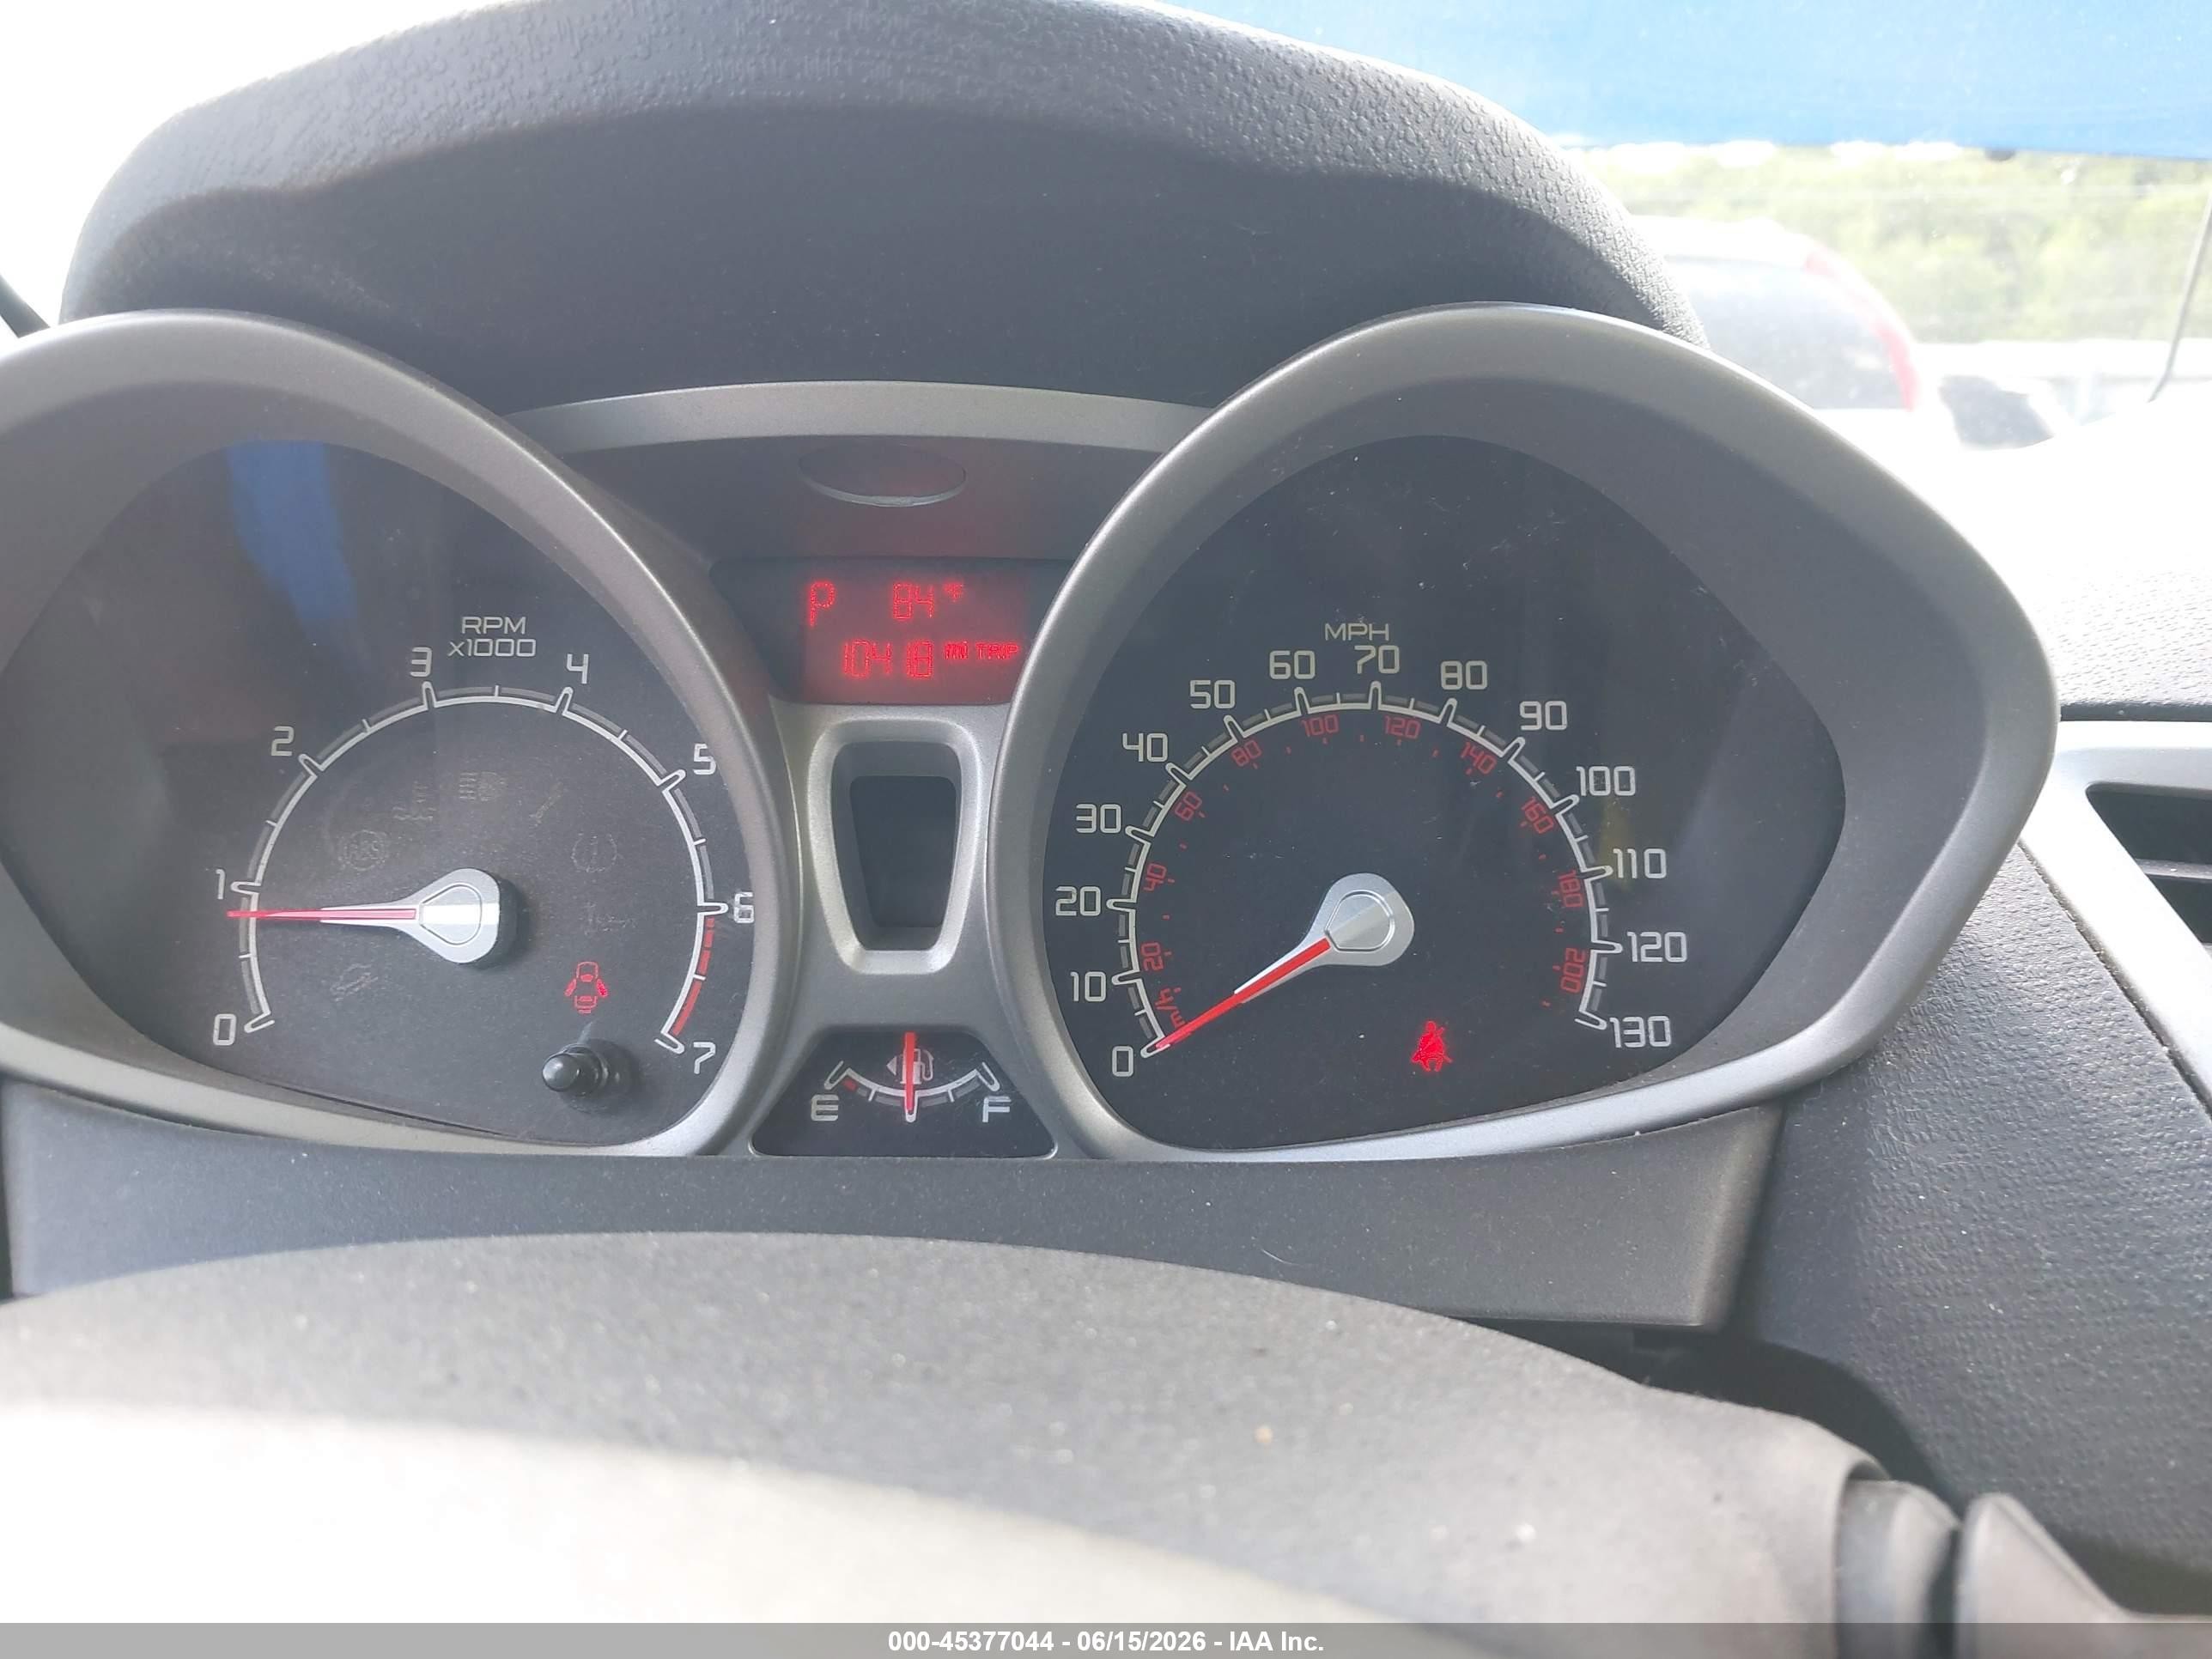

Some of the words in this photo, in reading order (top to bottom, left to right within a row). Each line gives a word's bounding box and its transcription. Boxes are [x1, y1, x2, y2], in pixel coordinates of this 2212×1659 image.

[809, 581, 836, 626] P
[892, 581, 934, 621] 84
[461, 617, 526, 635] RPM
[1325, 623, 1389, 641] MPH
[410, 647, 432, 677] 3
[975, 642, 1019, 659] TRIP
[1269, 650, 1316, 680] 60
[1354, 645, 1401, 674] 70
[567, 653, 589, 684] 4
[1441, 660, 1488, 690] 80
[1190, 679, 1236, 709] 50
[1301, 714, 1340, 738] 100
[1383, 715, 1421, 740] 120
[1520, 701, 1568, 731] 90
[271, 726, 295, 757] 2
[1122, 732, 1168, 763] 40
[1231, 740, 1262, 768] 80
[694, 744, 717, 775] 5
[1461, 742, 1498, 775] 140
[1576, 765, 1636, 796] 100
[1075, 804, 1121, 833] 30
[1174, 791, 1203, 821] 60
[1520, 795, 1553, 835] 160
[1144, 863, 1168, 891] 40
[1613, 848, 1667, 878] 110
[216, 868, 226, 899] 1
[1557, 870, 1584, 908] 180
[733, 891, 754, 922] 6
[1055, 886, 1101, 916] 20
[1139, 942, 1164, 971] 20
[1627, 932, 1687, 963] 120
[1560, 948, 1587, 994] 200
[1071, 971, 1106, 1002] 10
[213, 1014, 236, 1045] 0
[1610, 1016, 1671, 1048] 130
[694, 1042, 716, 1074] 7
[1112, 1046, 1133, 1077] 0
[811, 1094, 839, 1121] E
[981, 1096, 1012, 1123] F
